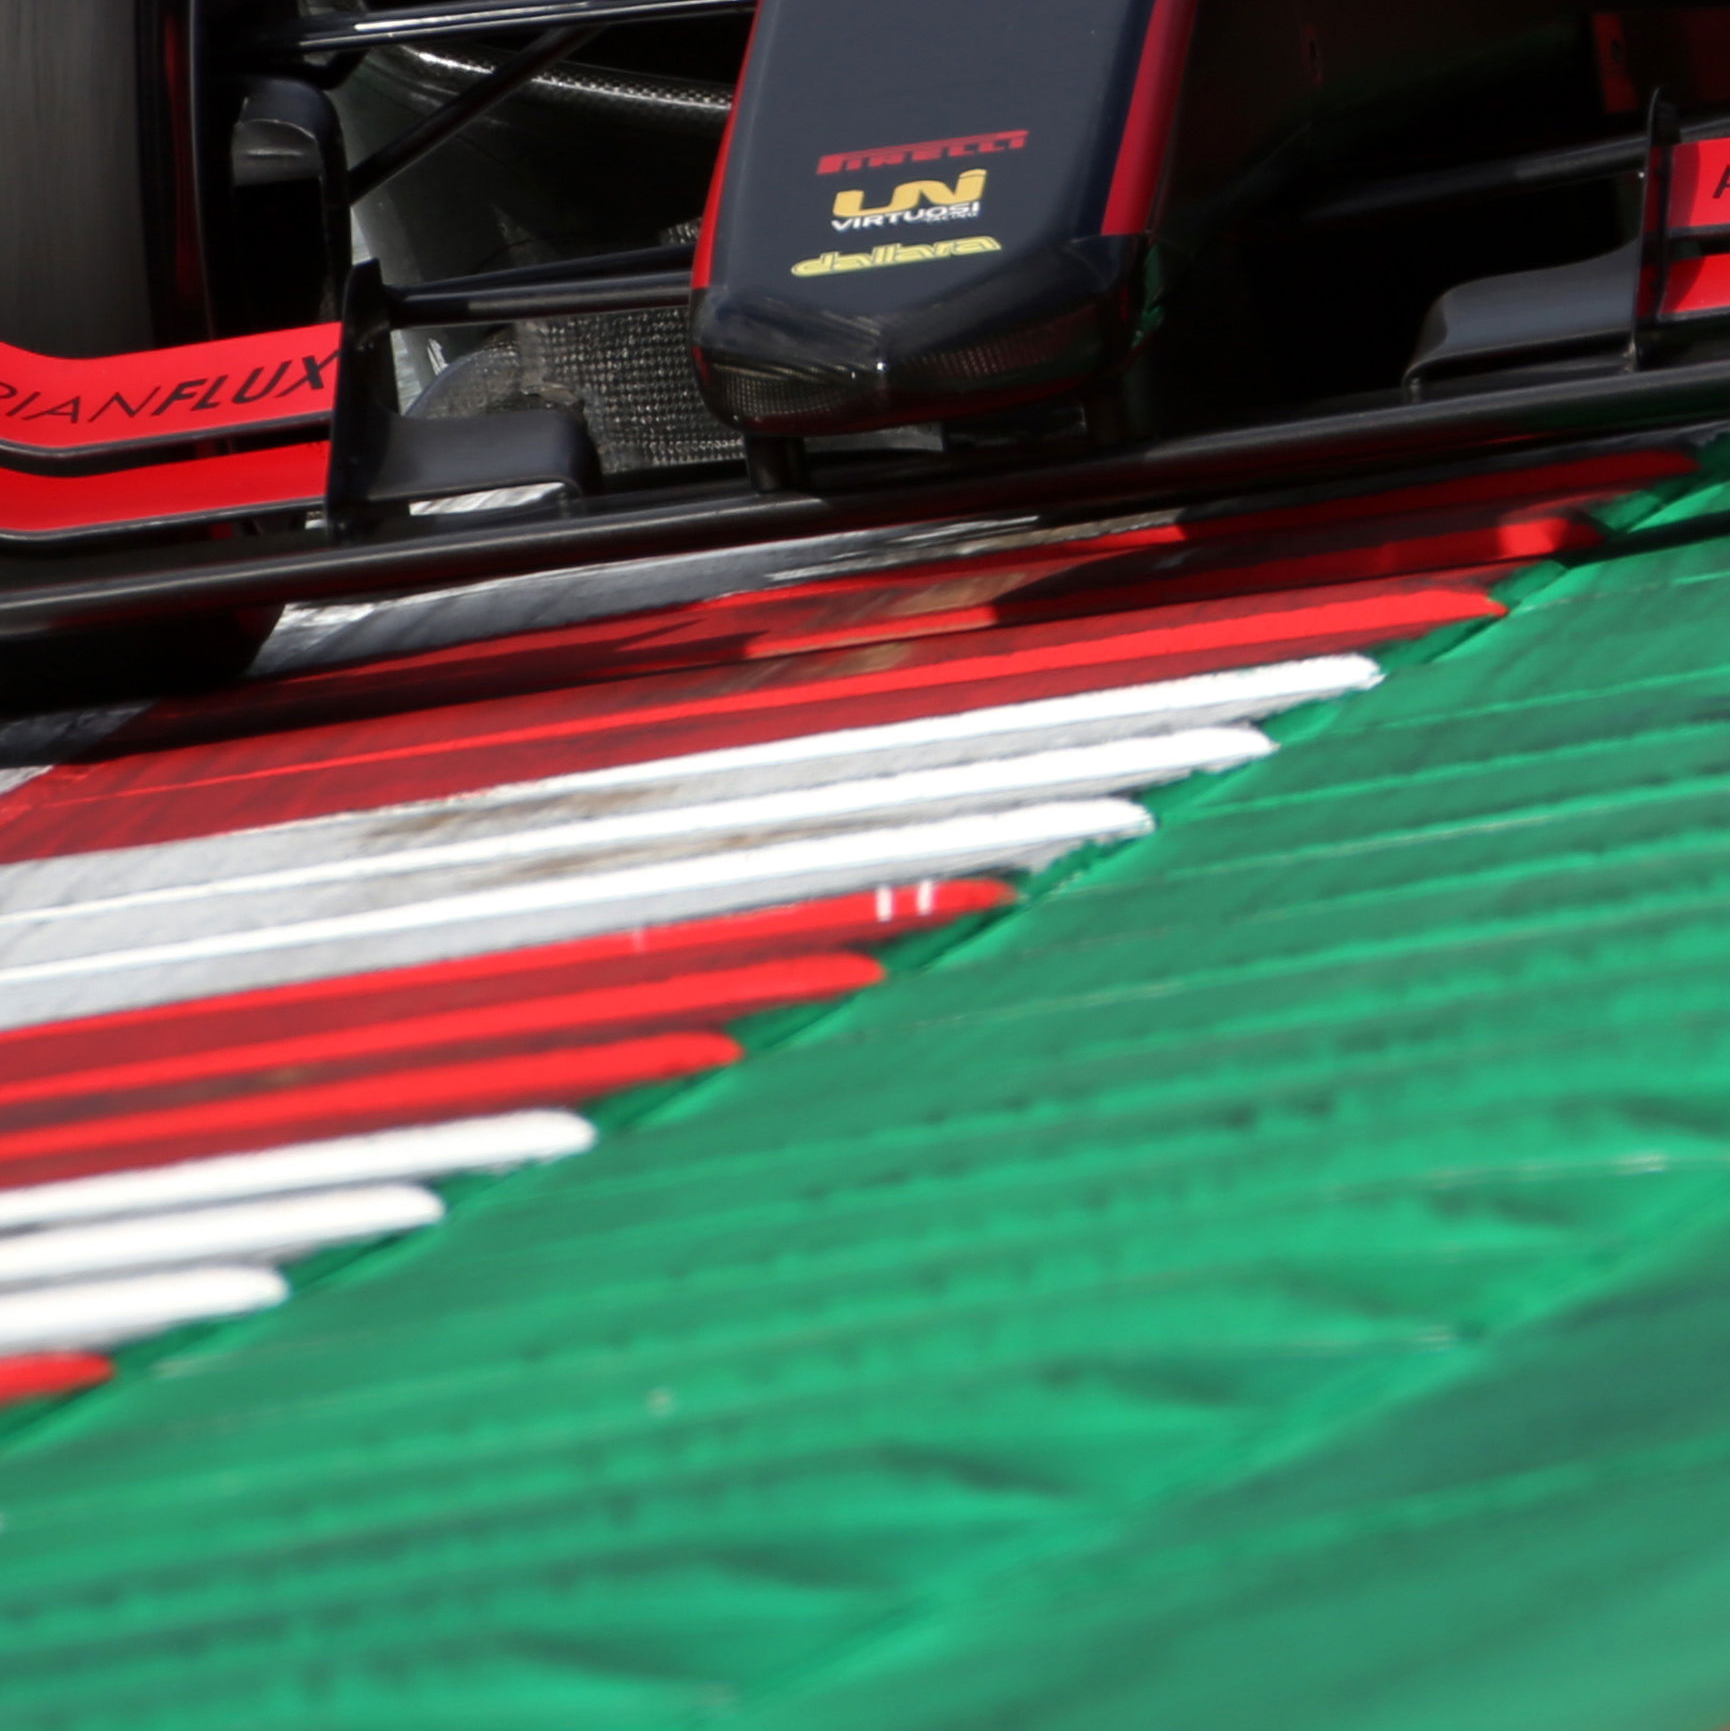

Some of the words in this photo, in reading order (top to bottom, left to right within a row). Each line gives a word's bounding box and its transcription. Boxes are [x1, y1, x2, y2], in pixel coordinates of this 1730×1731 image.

[816, 129, 1030, 175] PIRELLI
[831, 201, 981, 232] VIRTUOSI
[791, 235, 1002, 277] dallara
